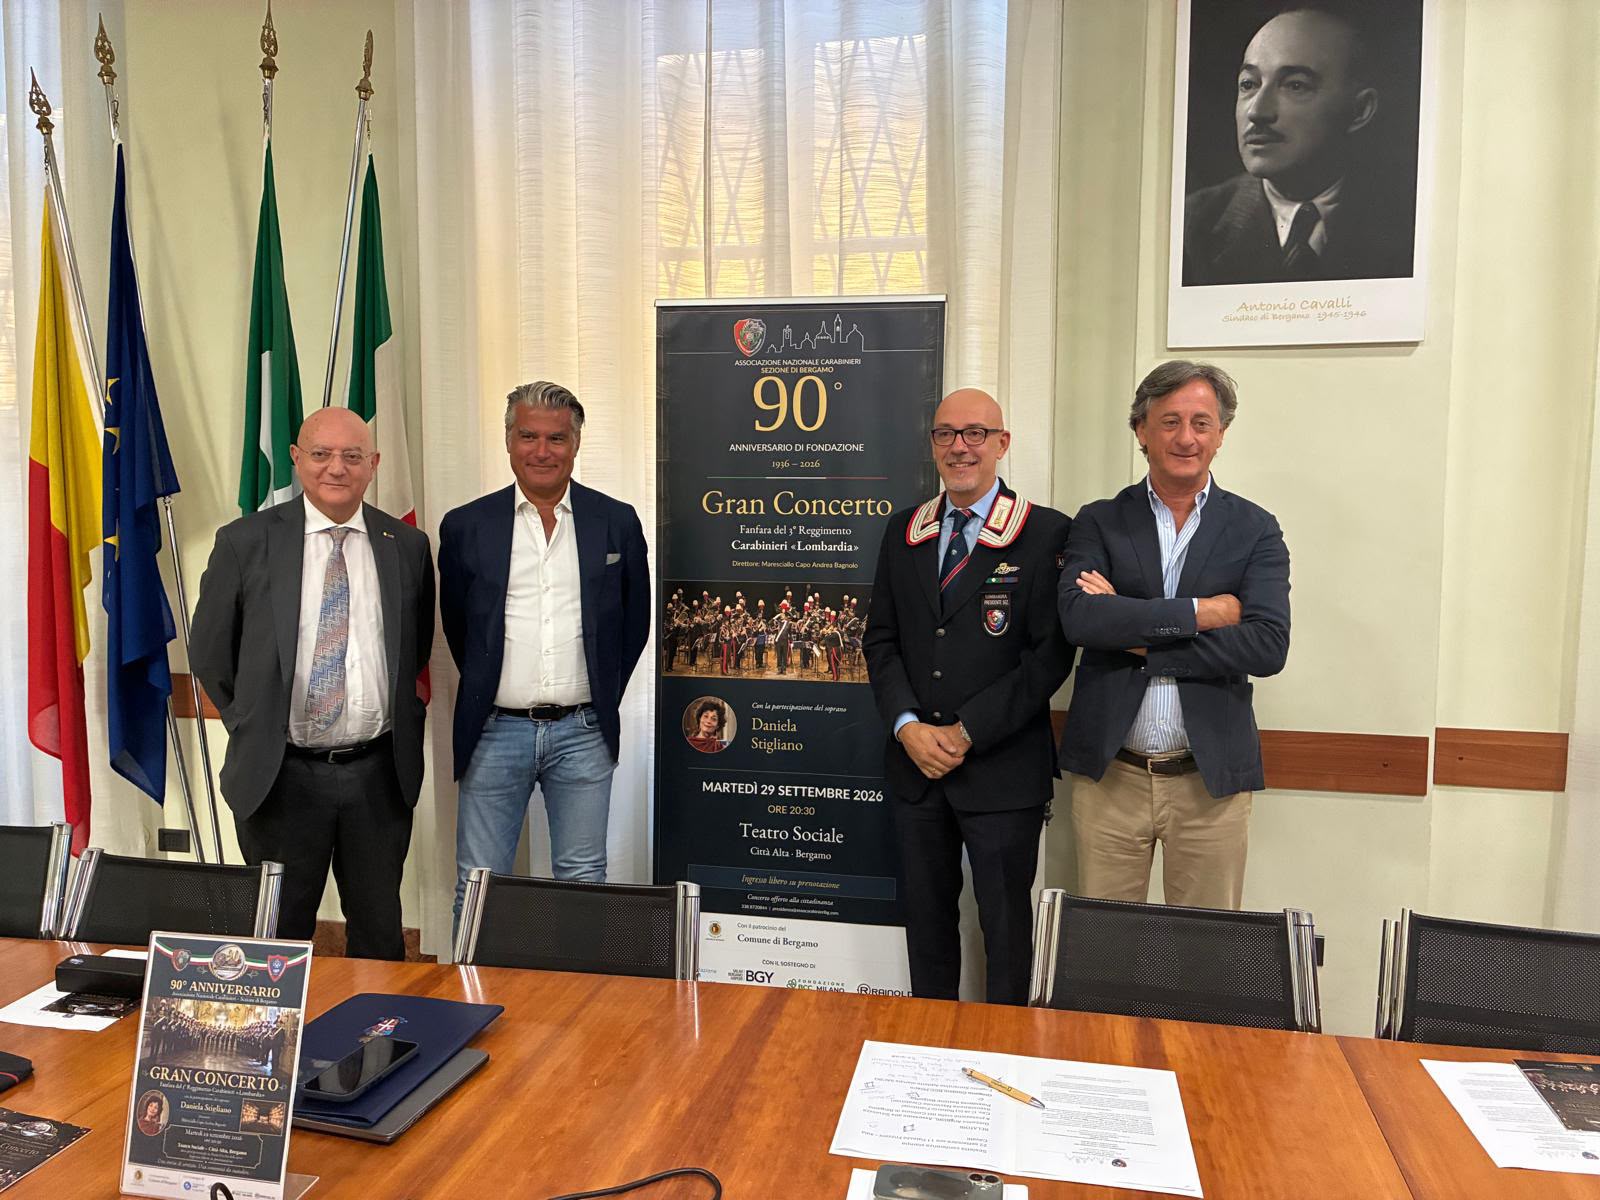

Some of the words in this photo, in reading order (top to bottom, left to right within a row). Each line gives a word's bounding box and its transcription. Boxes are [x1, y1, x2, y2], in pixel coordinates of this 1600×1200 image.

[1236, 298, 1296, 312] Antonio
[1300, 296, 1352, 310] Cavalli
[1222, 314, 1258, 323] Sindaco
[1260, 313, 1269, 321] di
[1272, 313, 1310, 323] Bergamo
[799, 366, 834, 374] BERGAMO
[729, 443, 793, 452] ANNIVERSARIO
[794, 443, 805, 452] DI
[806, 443, 864, 452] FONDAZIONE
[772, 460, 790, 468] 1936
[800, 460, 820, 468] 2026
[702, 490, 766, 516] Gran
[773, 490, 893, 516] Concerto
[740, 525, 771, 535] Fanfara
[773, 525, 787, 535] del
[798, 525, 852, 537] Reggimento
[731, 540, 788, 551] Carabinieri
[791, 541, 859, 552] «Lombardia»
[732, 560, 760, 568] Direttore:
[761, 560, 794, 568] Maresciallo
[796, 561, 811, 569] Capo
[812, 561, 833, 569] Andrea
[834, 561, 858, 570] Bagnolo
[751, 702, 763, 710] Con
[771, 704, 813, 713] partecipazione
[815, 704, 823, 712] del
[824, 706, 847, 714] soprano
[752, 718, 797, 732] Daniela
[751, 737, 803, 754] Stigliano
[702, 781, 758, 795] MARTEDÌ
[760, 784, 776, 796] 29
[778, 785, 850, 800] SETTEMBRE
[853, 790, 883, 802] 2026
[768, 804, 787, 814] ORE
[790, 806, 815, 816] 20:30
[738, 822, 789, 841] Teatro
[792, 825, 844, 844] Sociale
[750, 847, 770, 857] Città
[772, 848, 789, 857] Alta
[796, 850, 832, 861] Bergamo
[741, 874, 767, 885] Ingresso
[768, 876, 788, 885] libero
[789, 878, 797, 886] su
[797, 879, 840, 890] prenotazione
[752, 923, 777, 931] patrocinio
[737, 934, 771, 945] Comune
[773, 934, 781, 945] di
[782, 937, 819, 949] Bergamo
[745, 970, 774, 983] BGY
[170, 979, 187, 991] 90°
[189, 981, 281, 998] ANNIVERSARIO
[150, 1066, 191, 1083] GRAN
[194, 1071, 279, 1092] CONCERTO
[180, 1101, 203, 1111] Daniela
[204, 1103, 232, 1114] Stigliano
